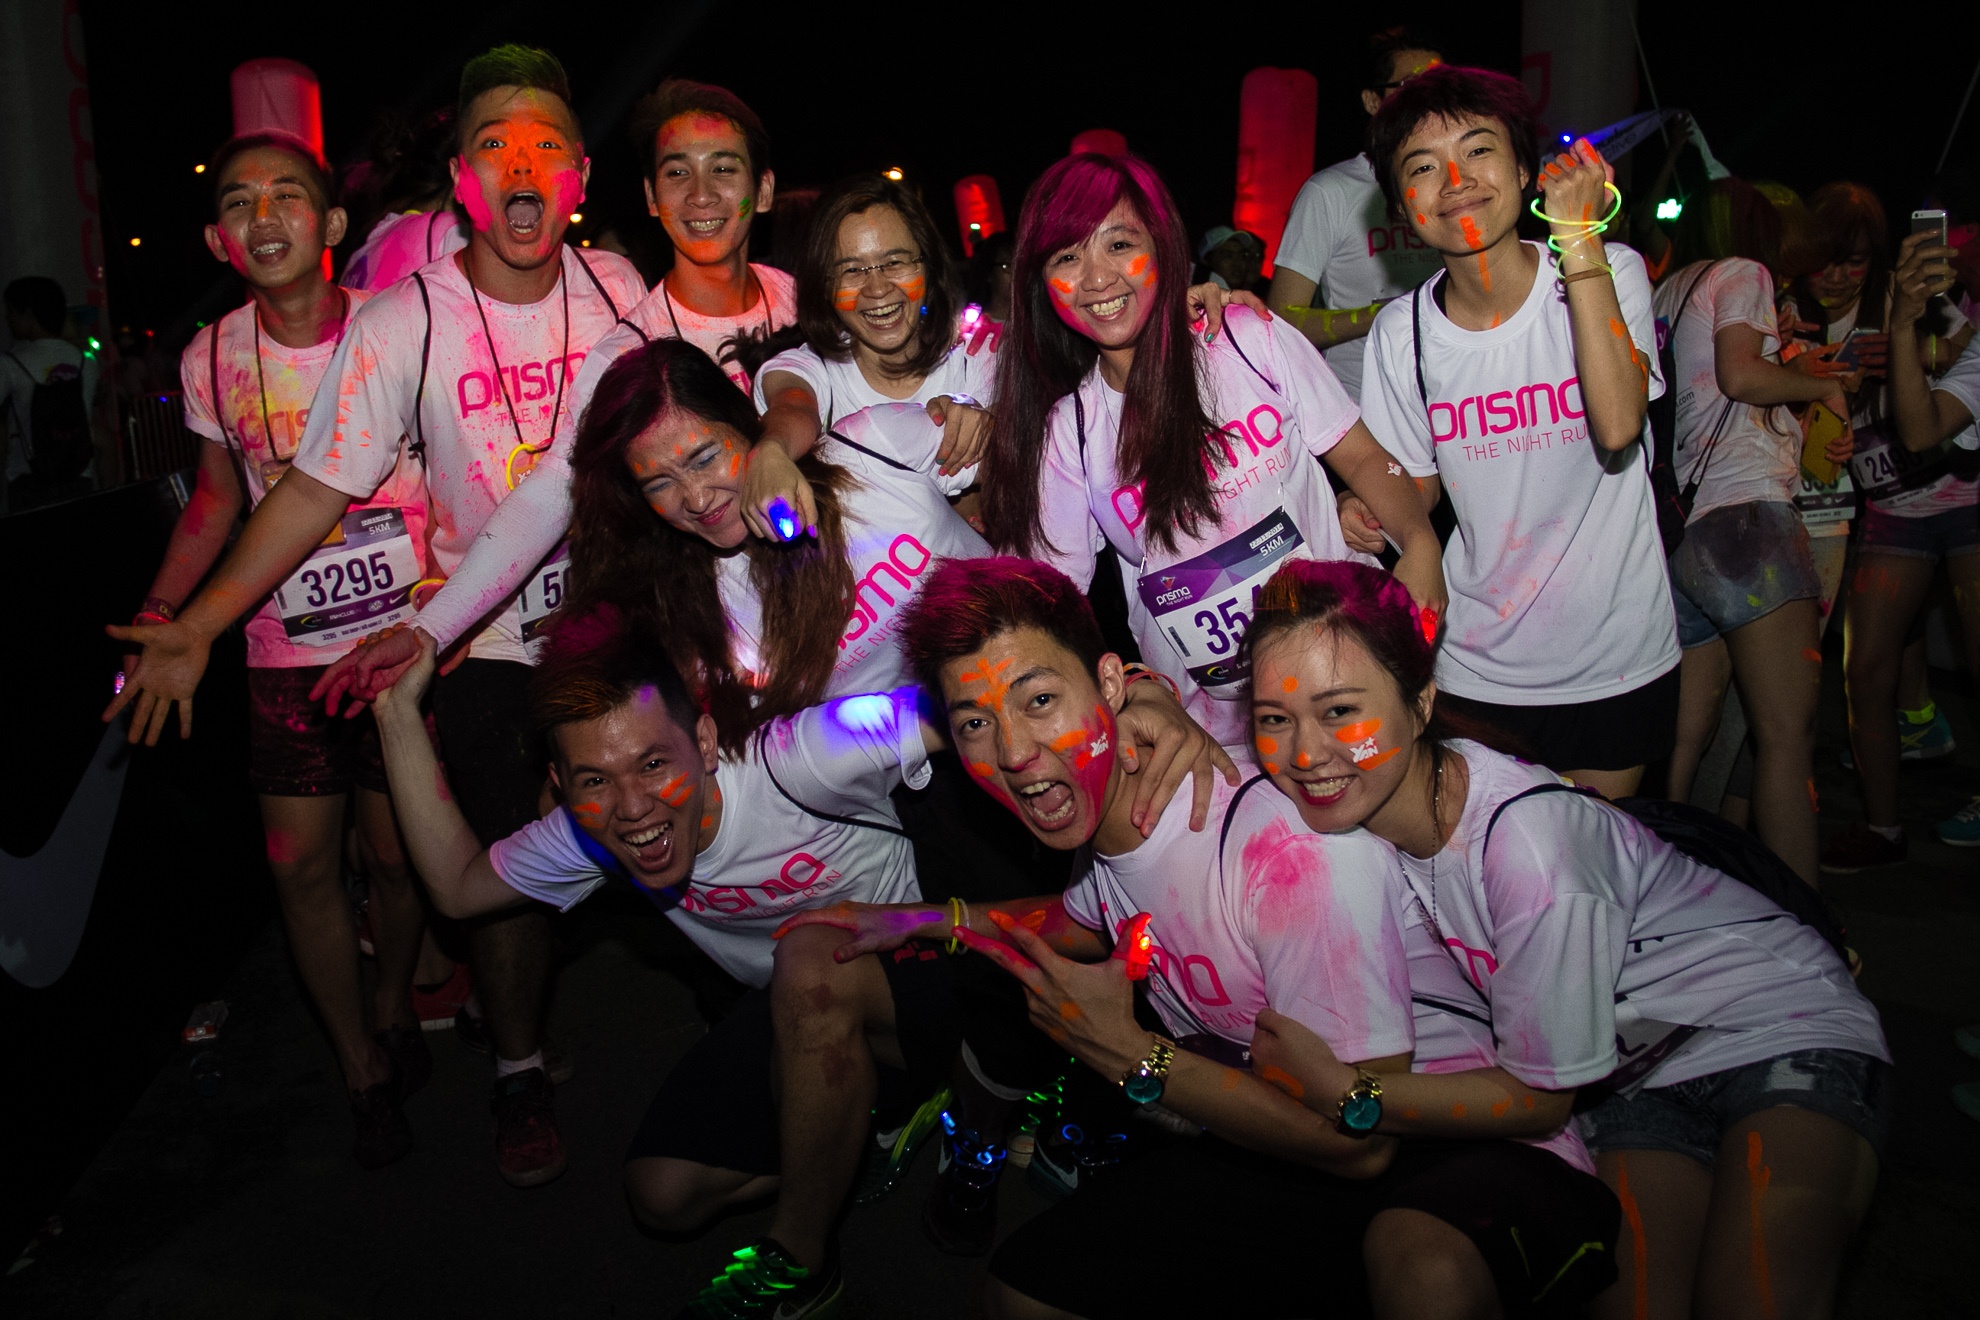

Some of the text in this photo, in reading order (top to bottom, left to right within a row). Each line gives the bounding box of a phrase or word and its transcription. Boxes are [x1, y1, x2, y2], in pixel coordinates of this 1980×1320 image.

[1462, 441, 1500, 461] THE
[1561, 423, 1589, 445] RU
[1212, 447, 1292, 507] IGHT RUN
[369, 522, 391, 535] 5KM
[1260, 535, 1284, 556] 5KM
[301, 551, 394, 607] 3295
[833, 645, 871, 673] THE
[802, 869, 842, 900] RUN
[1200, 1011, 1251, 1030] RUN
